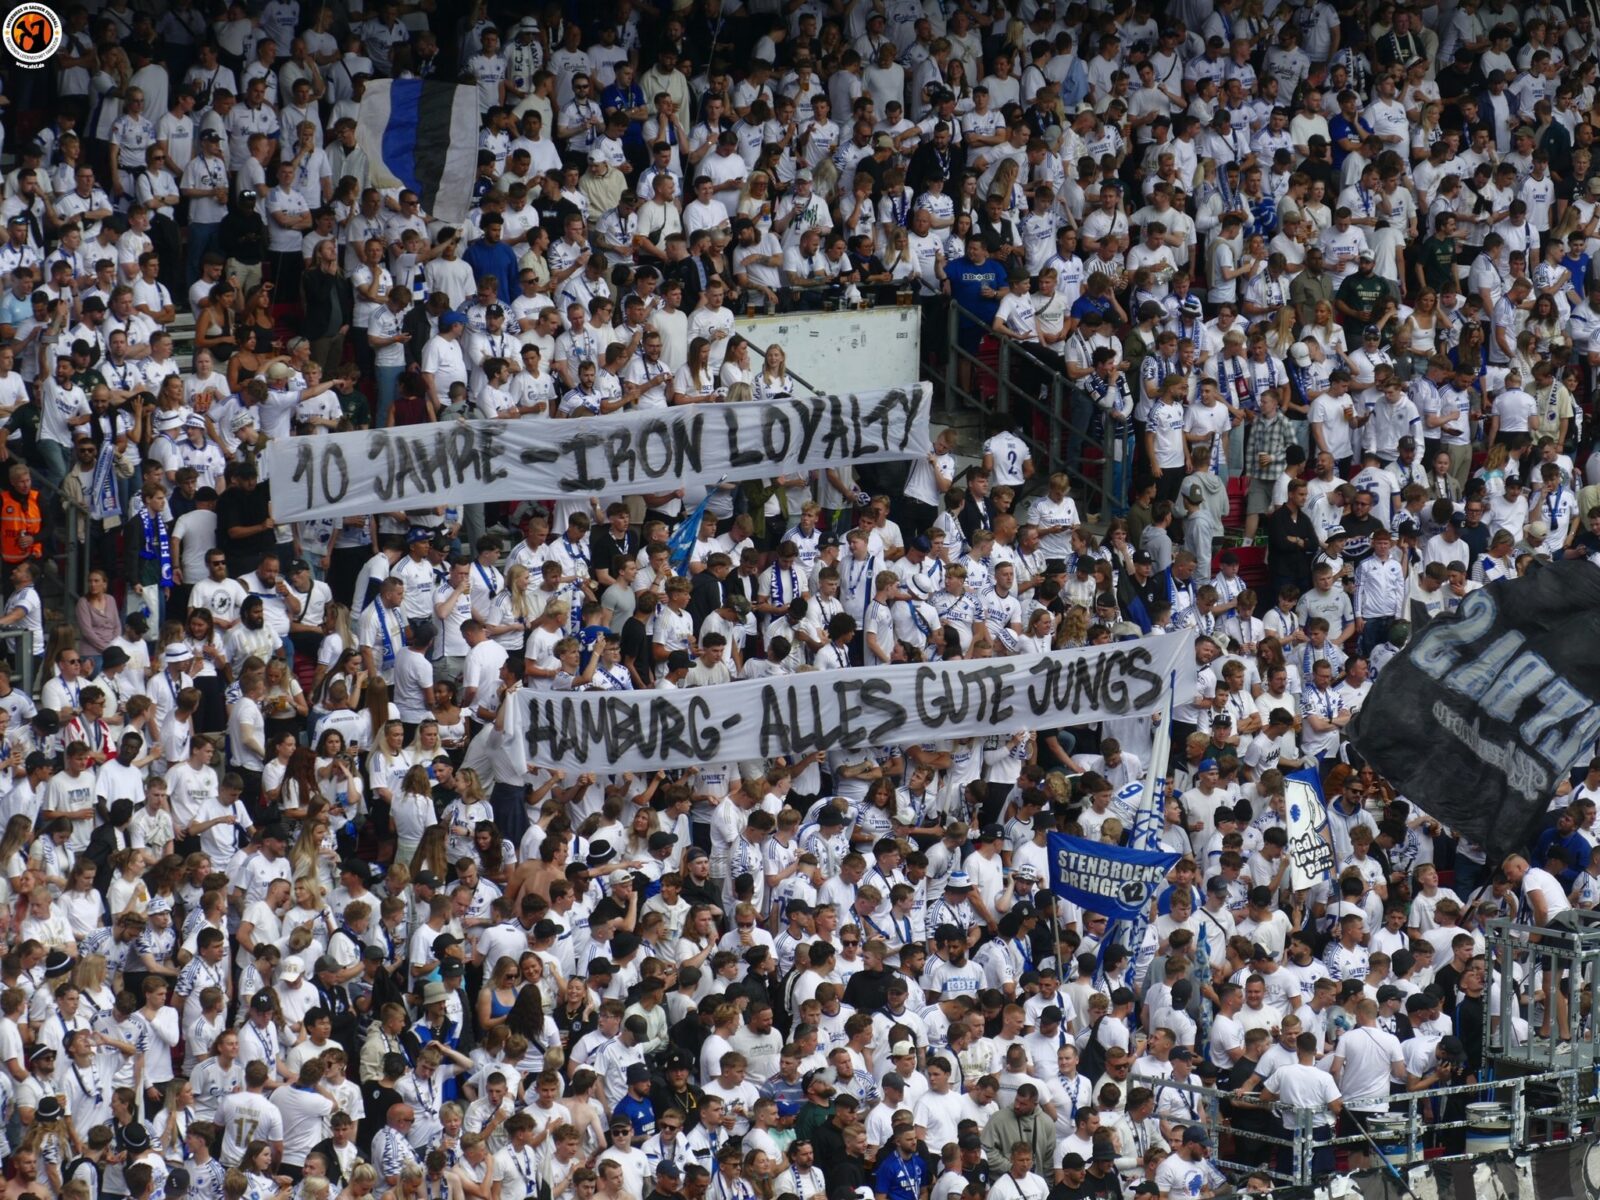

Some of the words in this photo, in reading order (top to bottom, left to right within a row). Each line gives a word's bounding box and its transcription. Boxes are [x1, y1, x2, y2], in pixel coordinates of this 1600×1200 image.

[1089, 142, 1111, 152] UNIBET
[292, 443, 349, 510] 10
[368, 420, 508, 500] JAHRE
[558, 412, 704, 493] IRON
[725, 383, 924, 468] LOYALTY
[1007, 451, 1018, 475] 2
[987, 609, 1008, 619] UNIBET
[760, 679, 908, 757] ALLES
[916, 664, 1016, 728] GUTE
[1028, 646, 1163, 716] JUNGS
[1058, 850, 1165, 882] STENBROENS
[1060, 868, 1121, 898] DRENGE
[1121, 882, 1144, 903] 12
[234, 1118, 259, 1147] 17
